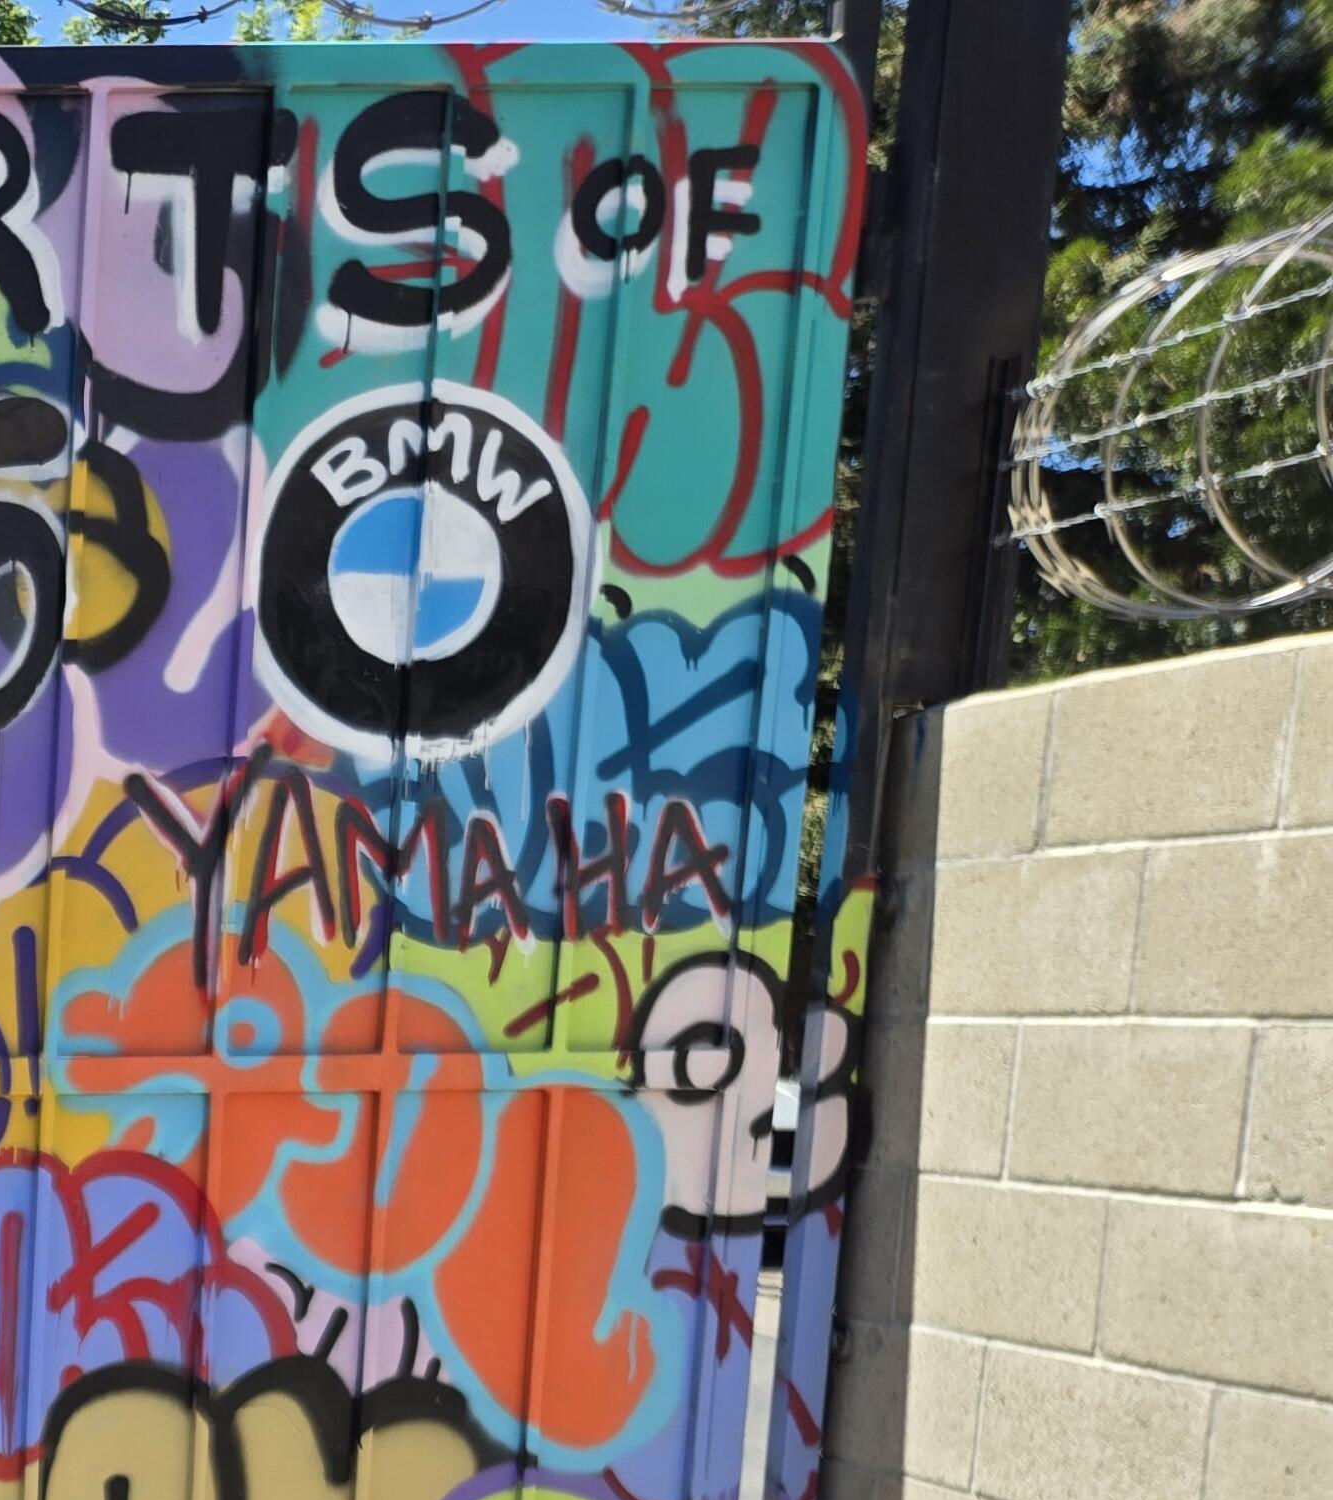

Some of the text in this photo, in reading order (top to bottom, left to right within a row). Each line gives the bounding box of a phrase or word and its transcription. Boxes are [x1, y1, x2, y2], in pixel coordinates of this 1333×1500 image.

[563, 144, 761, 288] OF
[311, 410, 553, 523] BMW
[126, 742, 731, 985] YAMAHA
